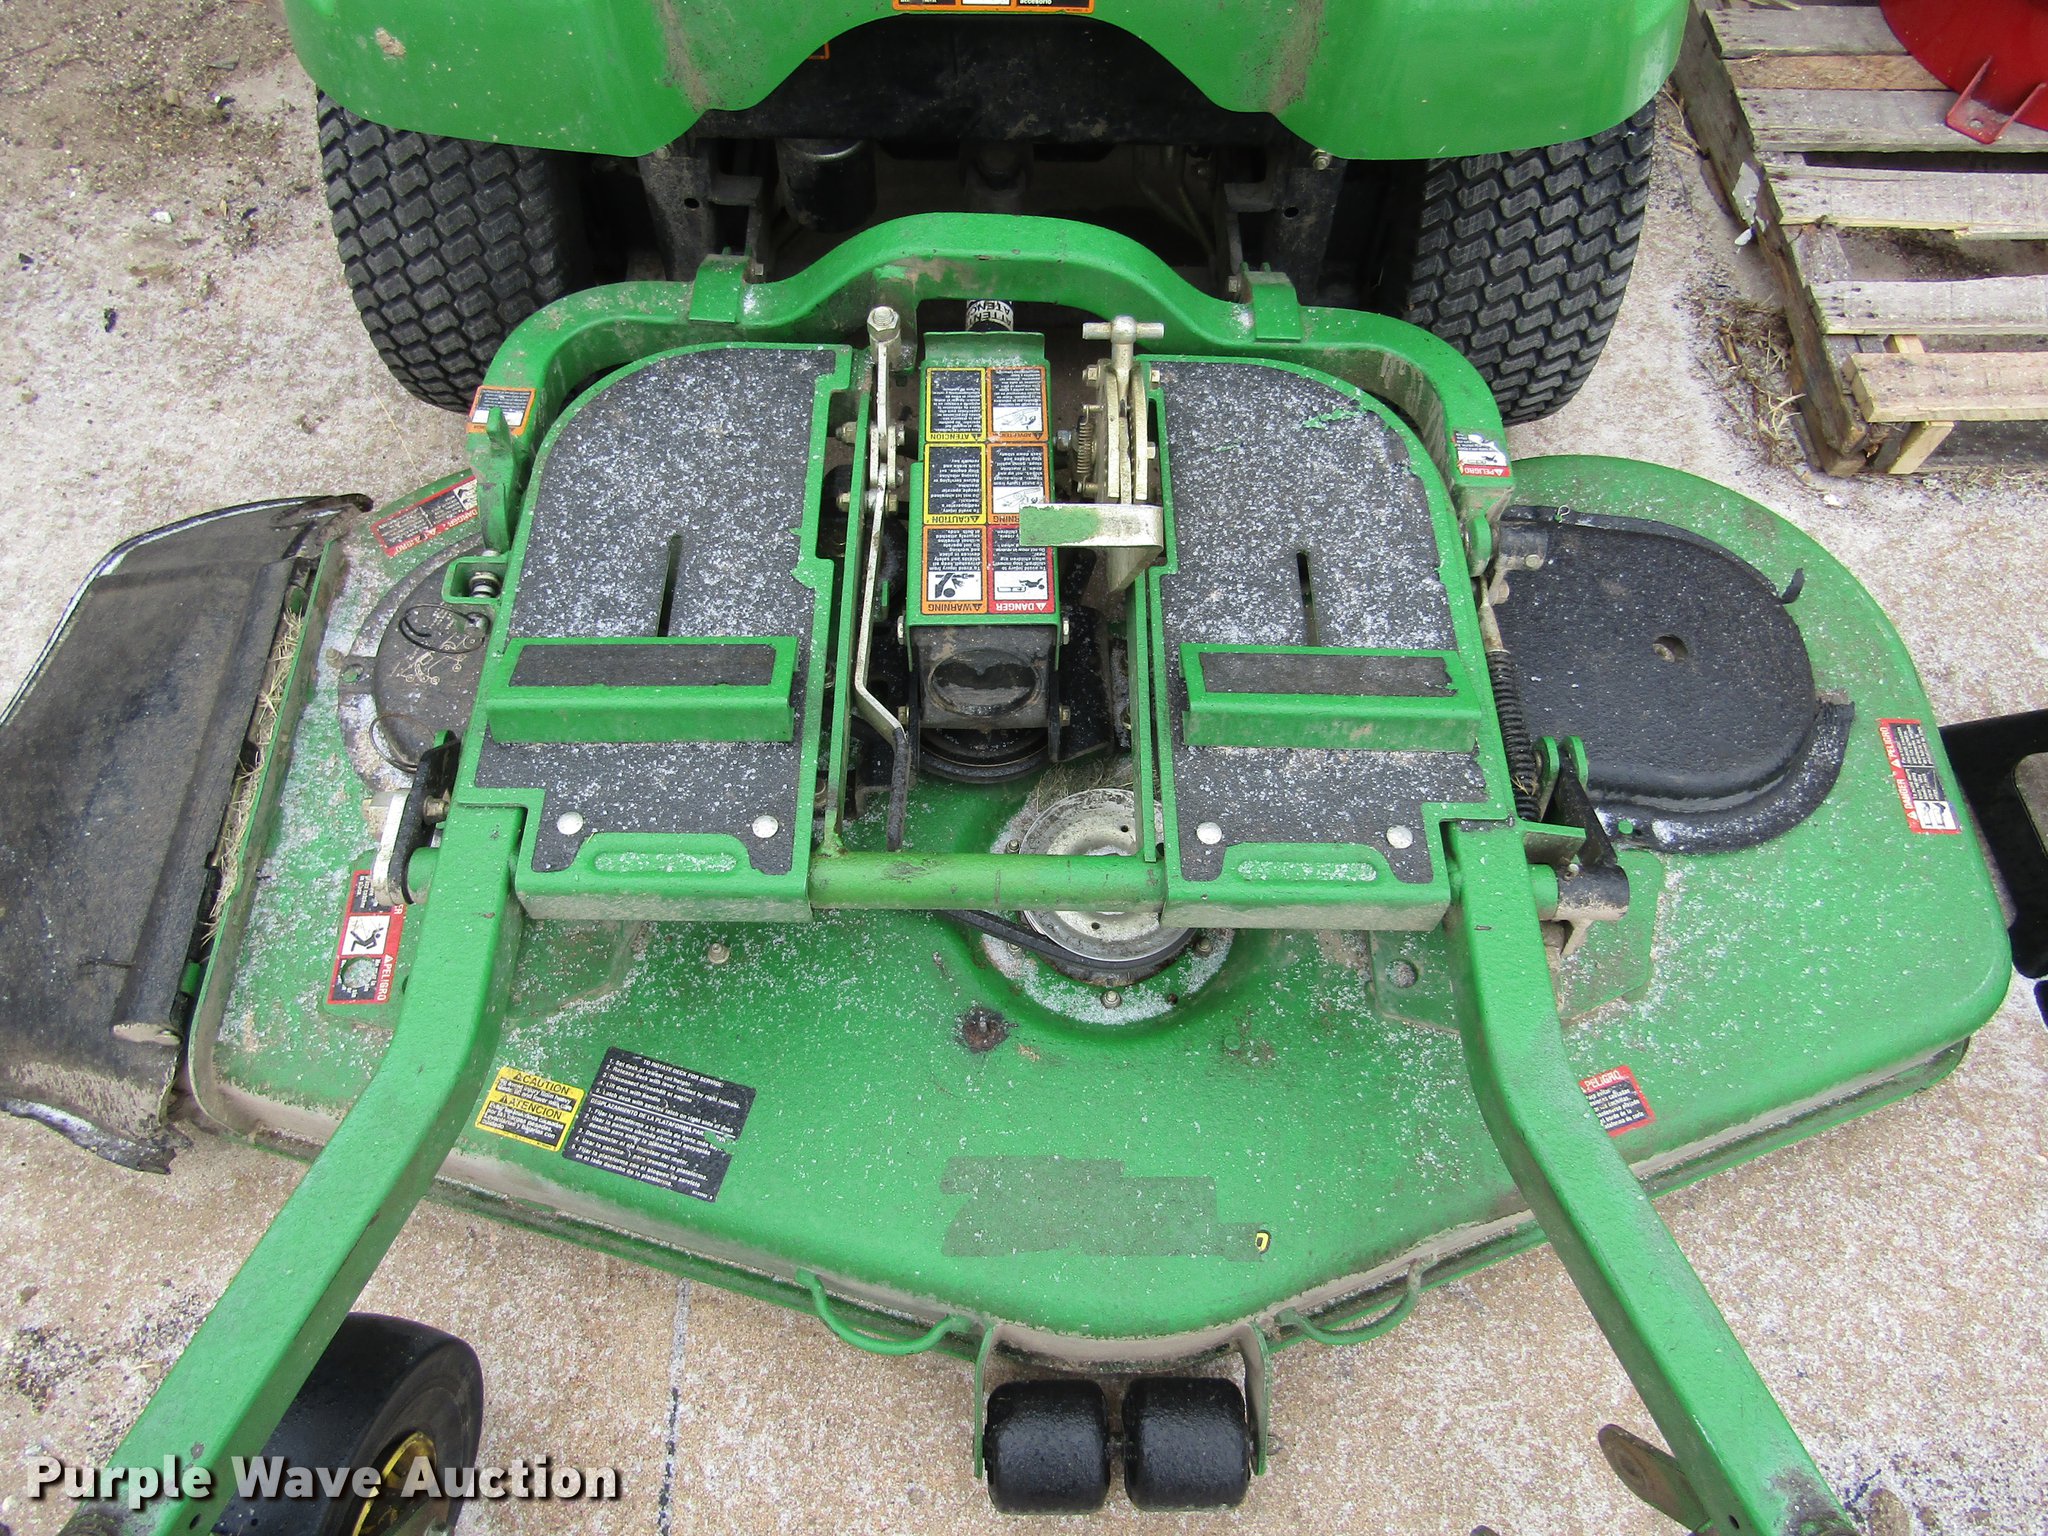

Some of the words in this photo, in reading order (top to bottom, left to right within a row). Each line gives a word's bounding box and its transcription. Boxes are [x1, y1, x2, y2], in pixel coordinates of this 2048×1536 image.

[1880, 726, 1897, 759] PELIGRO
[1897, 778, 1915, 809] DANGER
[377, 962, 392, 1001] PELIGRO
[650, 1061, 672, 1072] ROTATE
[672, 1067, 687, 1076] DECK
[687, 1072, 699, 1080] FOR
[1584, 1070, 1621, 1090] PELIGRO
[521, 1074, 570, 1094] CAUTION
[508, 1097, 562, 1119] ATENCION
